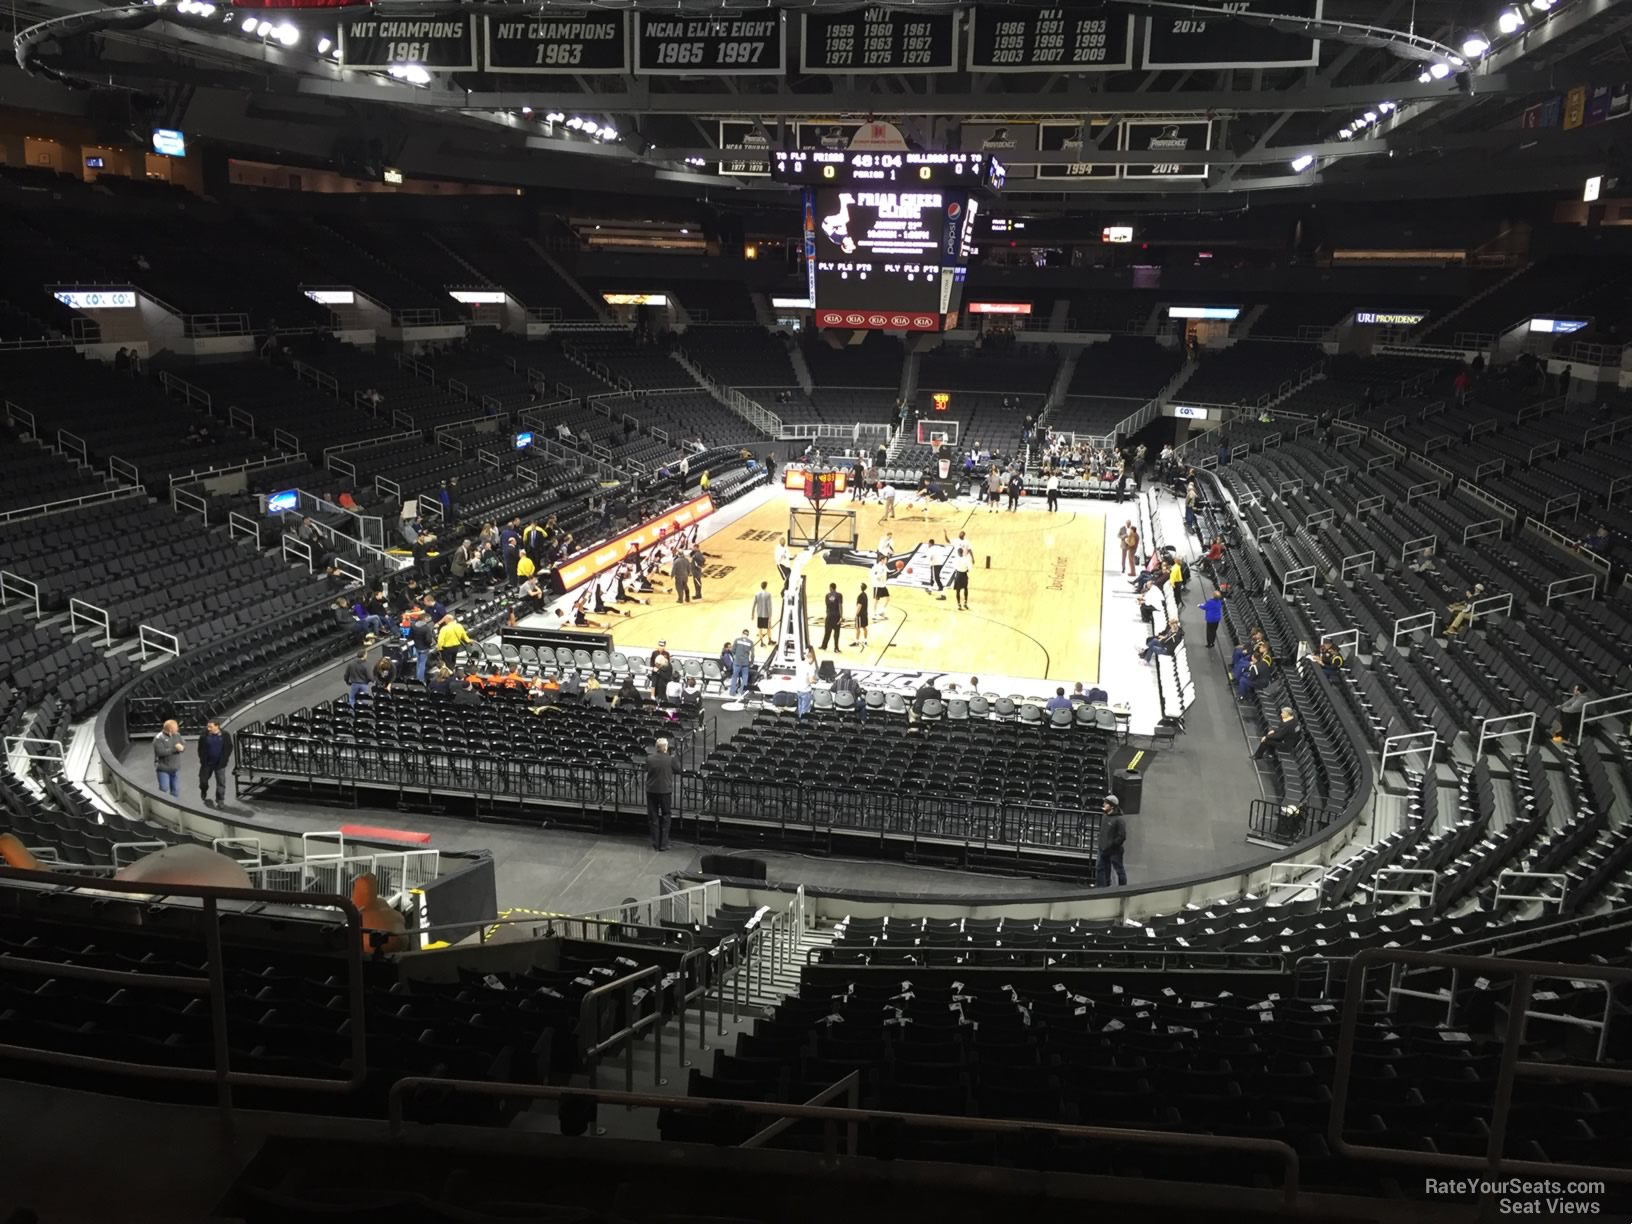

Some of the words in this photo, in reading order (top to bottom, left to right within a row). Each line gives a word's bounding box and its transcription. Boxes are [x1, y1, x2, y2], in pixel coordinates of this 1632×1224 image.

[868, 8, 891, 22] NIT
[350, 22, 376, 38] NIT
[379, 22, 463, 38] CHAMPIONS
[497, 23, 525, 39] NIT
[528, 23, 615, 40] CHAMPIONS
[645, 22, 685, 37] NCAA
[687, 22, 729, 37] ELITE
[730, 21, 775, 37] EIGHT
[826, 25, 855, 37] 1959
[864, 24, 893, 36] 1960
[903, 23, 931, 36] 1961
[995, 22, 1025, 35] 1986
[1035, 21, 1064, 34] 1991
[1076, 20, 1106, 33] 1993
[1172, 20, 1206, 33] 2013
[826, 38, 854, 50] 1962
[864, 37, 892, 50] 1963
[903, 37, 932, 49] 1967
[994, 36, 1024, 49] 1995
[1034, 35, 1064, 48] 1996
[1075, 34, 1106, 47] 1999
[387, 42, 430, 62] 1961
[536, 44, 583, 64] 1963
[656, 42, 704, 63] 1965
[716, 42, 764, 63] 1997
[826, 52, 853, 64] 1971
[864, 51, 892, 63] 1975
[902, 51, 931, 63] 1976
[992, 50, 1024, 62] 2003
[1032, 49, 1064, 61] 2007
[1073, 48, 1106, 61] 2009
[1150, 138, 1188, 149] PROVIDENCE
[823, 165, 835, 178] 0
[890, 169, 896, 180] 1
[920, 166, 931, 178] 0
[1066, 164, 1093, 175] 1994
[1152, 163, 1180, 174] 2014
[947, 222, 956, 255] pepsi
[1357, 313, 1375, 323] URI
[821, 482, 833, 497] 30
